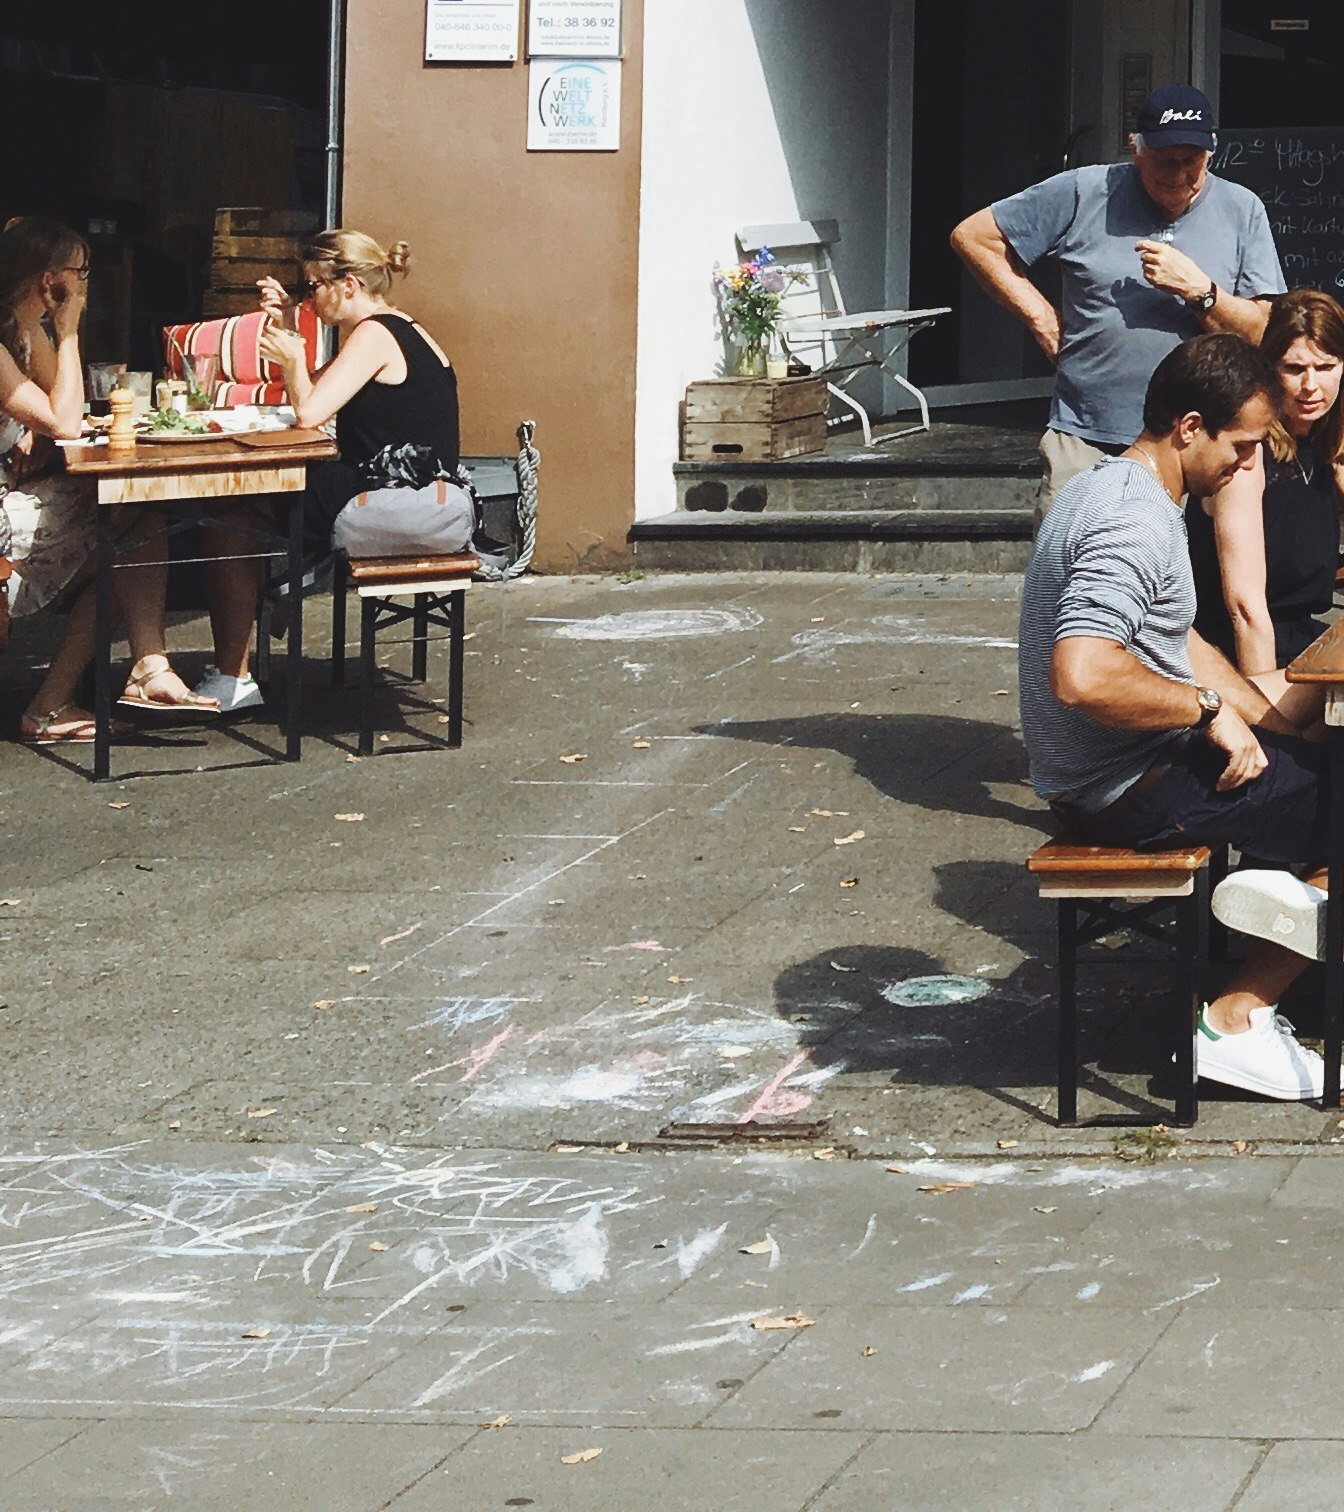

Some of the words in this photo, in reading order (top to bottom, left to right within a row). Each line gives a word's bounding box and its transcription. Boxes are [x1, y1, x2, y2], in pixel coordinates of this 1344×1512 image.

[564, 17, 580, 28] 38
[582, 17, 598, 28] 36
[600, 17, 616, 28] 92
[560, 77, 591, 89] EINE
[553, 90, 592, 102] WELT
[549, 102, 586, 115] NETZ
[553, 115, 597, 128] WERK
